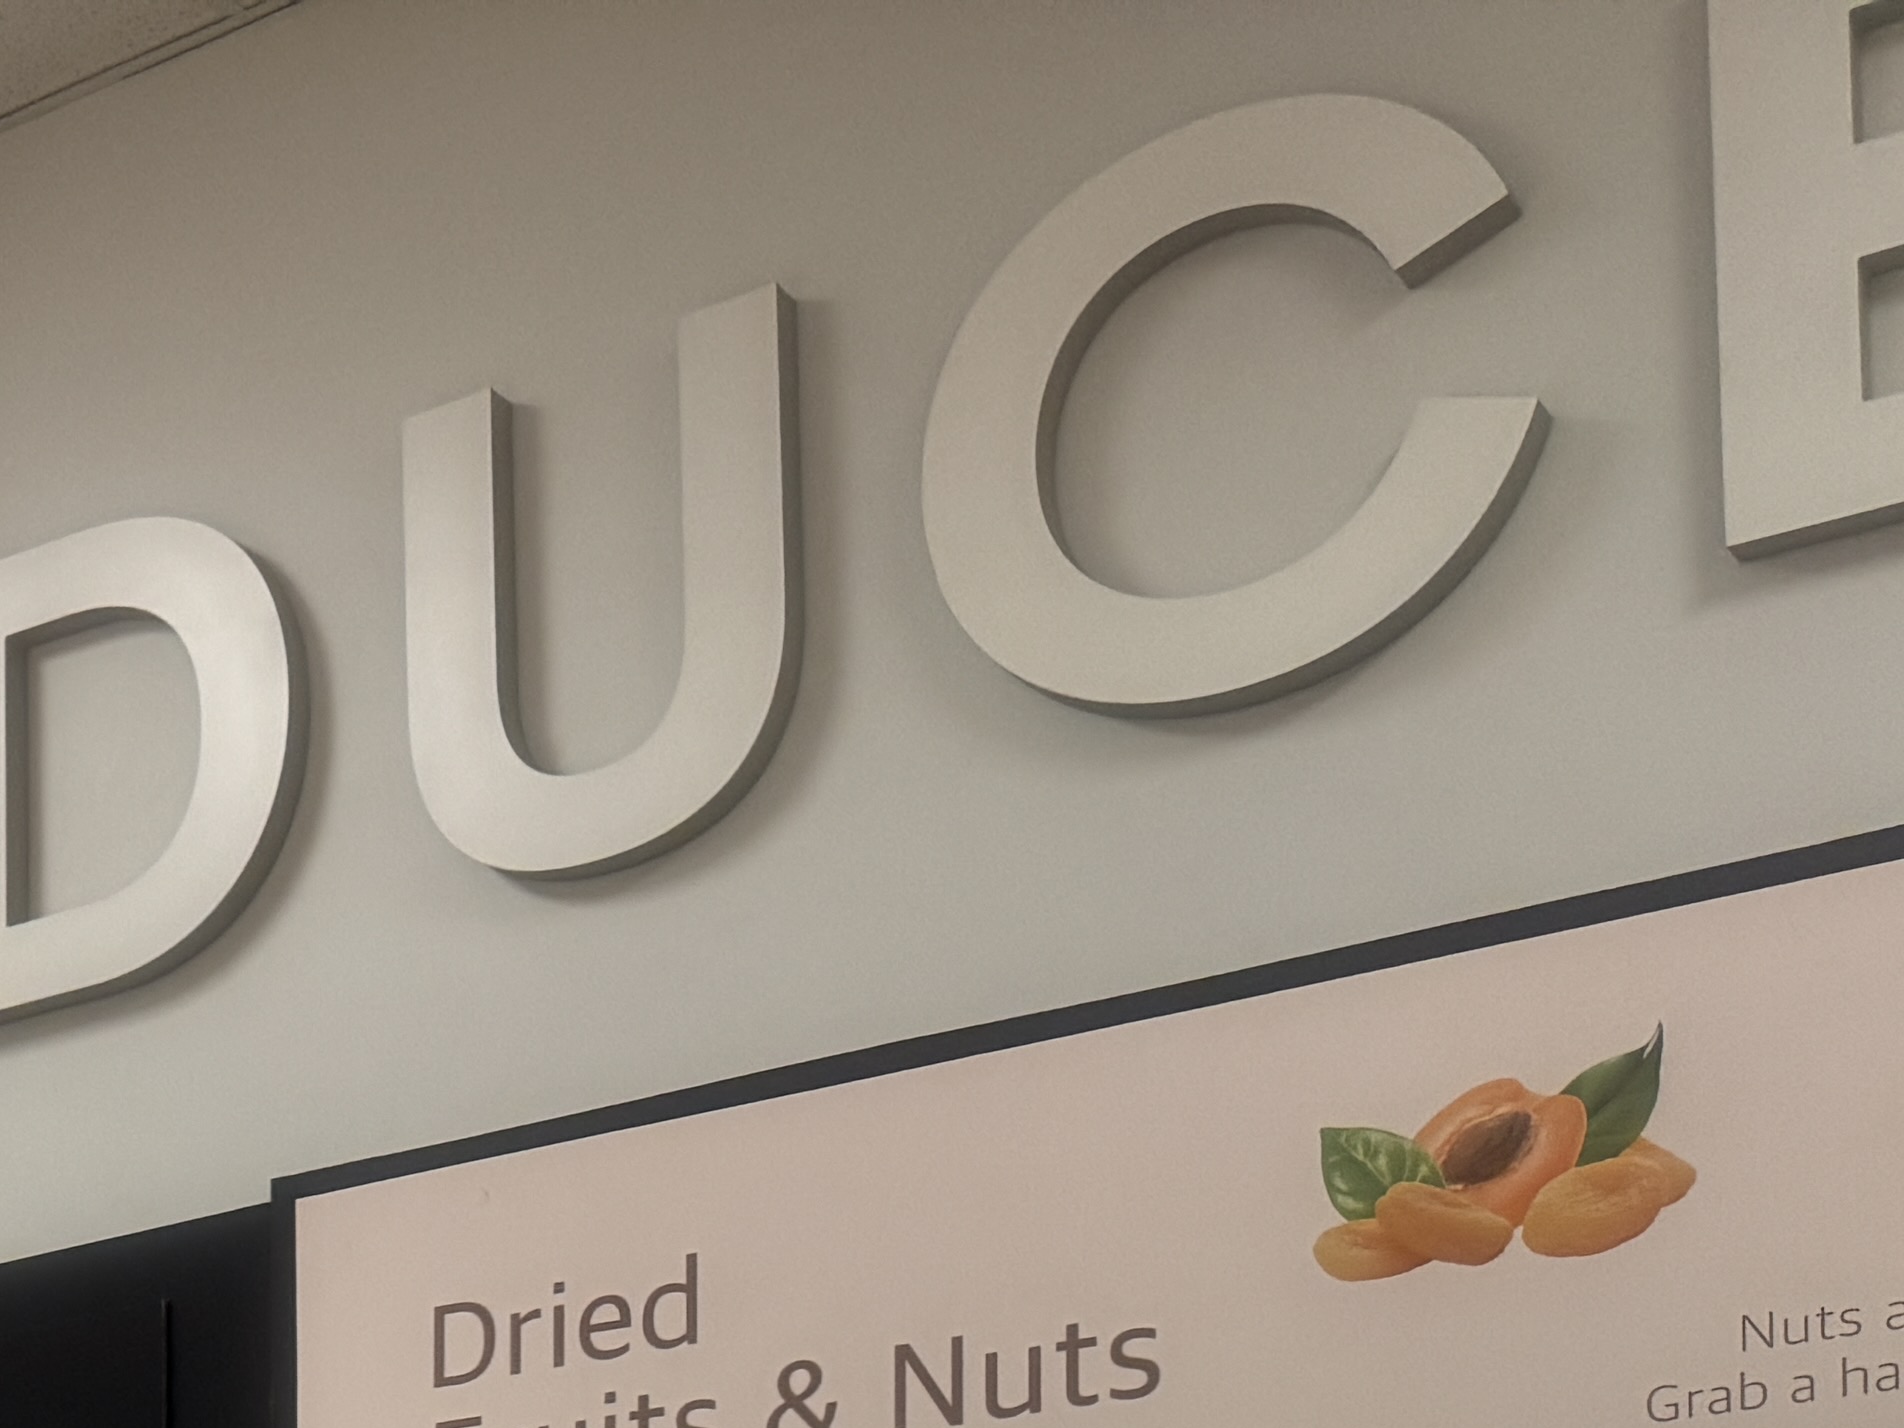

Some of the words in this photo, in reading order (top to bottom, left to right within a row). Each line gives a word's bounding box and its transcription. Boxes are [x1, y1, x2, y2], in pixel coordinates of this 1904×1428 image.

[430, 1253, 699, 1389] Dried
[1741, 1306, 1862, 1352] Nuts
[1646, 1371, 1768, 1423] Grab
[1791, 1374, 1814, 1404] a
